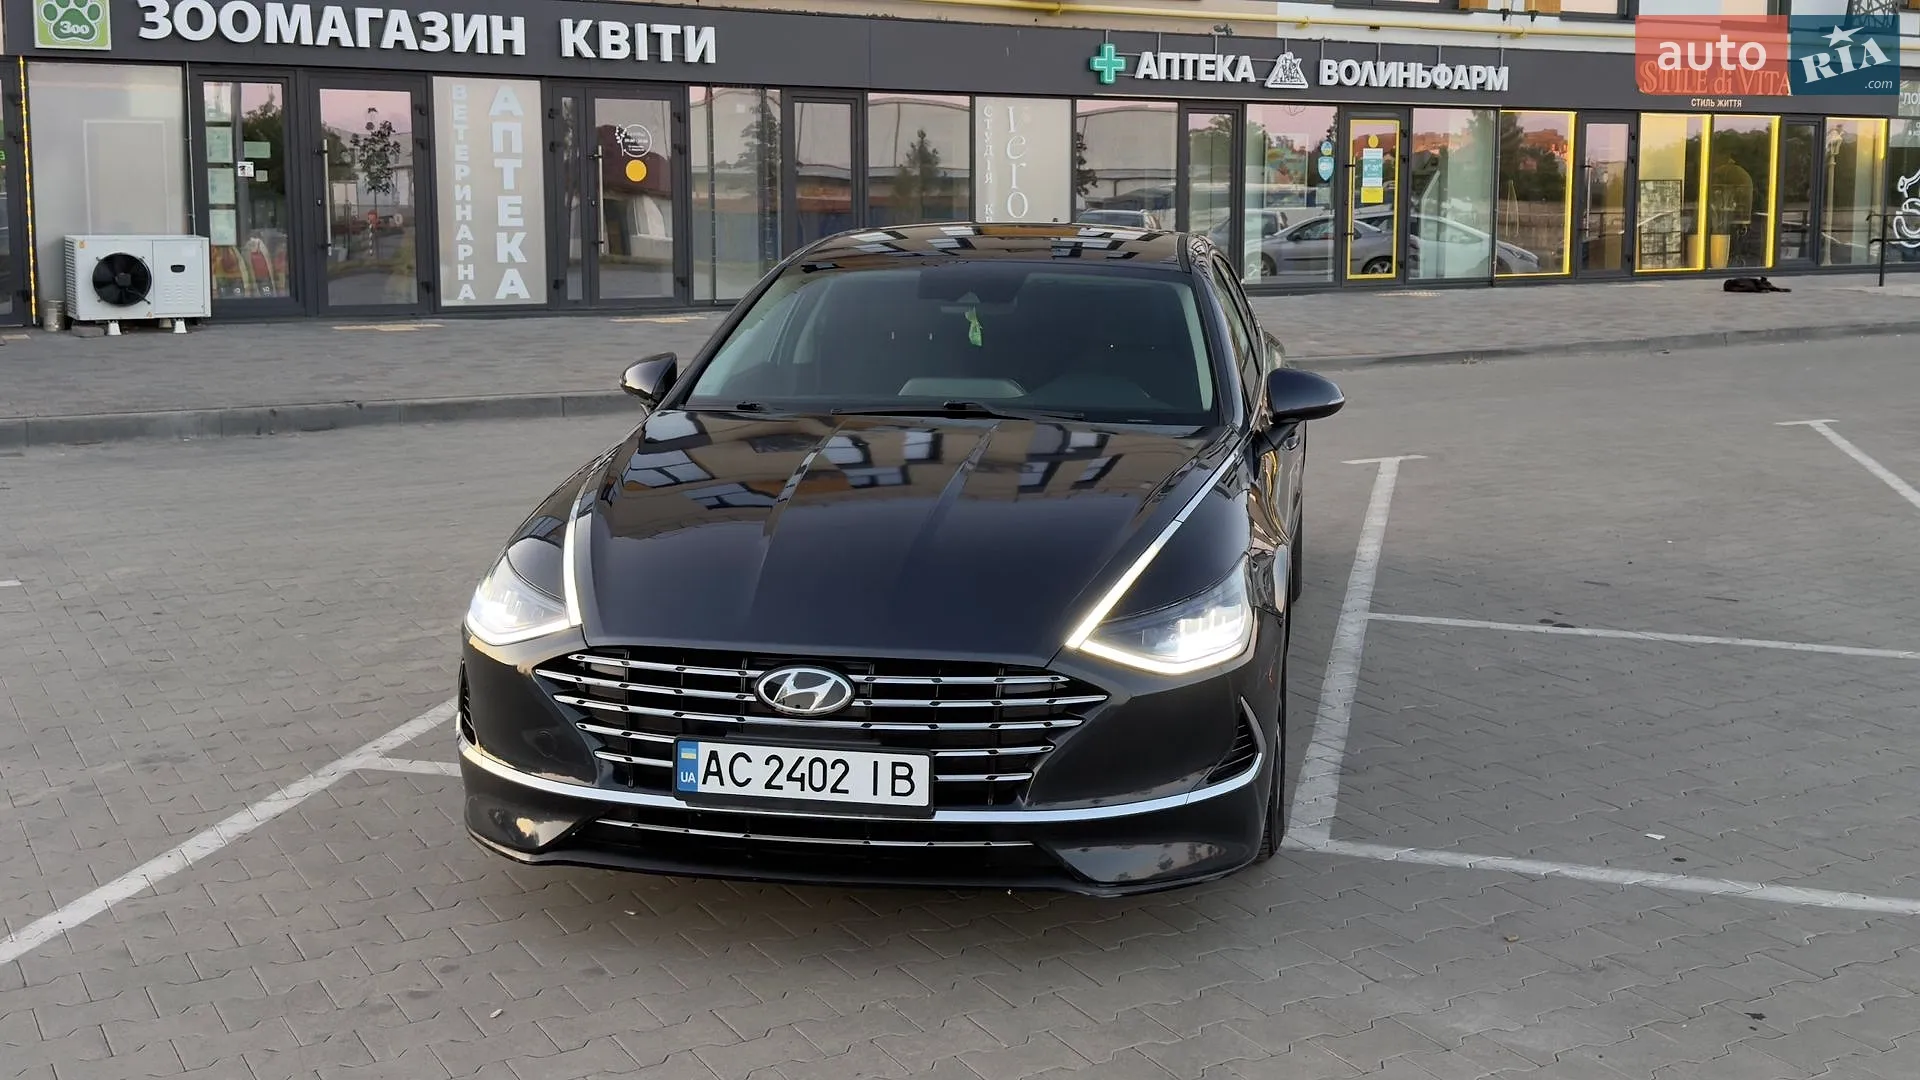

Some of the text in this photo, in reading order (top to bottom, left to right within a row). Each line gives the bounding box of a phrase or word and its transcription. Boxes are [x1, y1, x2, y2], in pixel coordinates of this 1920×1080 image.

[137, 0, 717, 64] ЗООМАГАЗИН КВІТИ
[1134, 51, 1510, 92] АПТЕКА ВОЛИНЬФАРМ
[1691, 98, 1742, 108] СТИЛЬ ЖИТТЯ
[452, 84, 476, 301] ВЕТЕРИНАРНА
[489, 85, 531, 300] АПТЕКА
[680, 771, 696, 784] UA
[702, 749, 916, 798] AC 2402 IB
